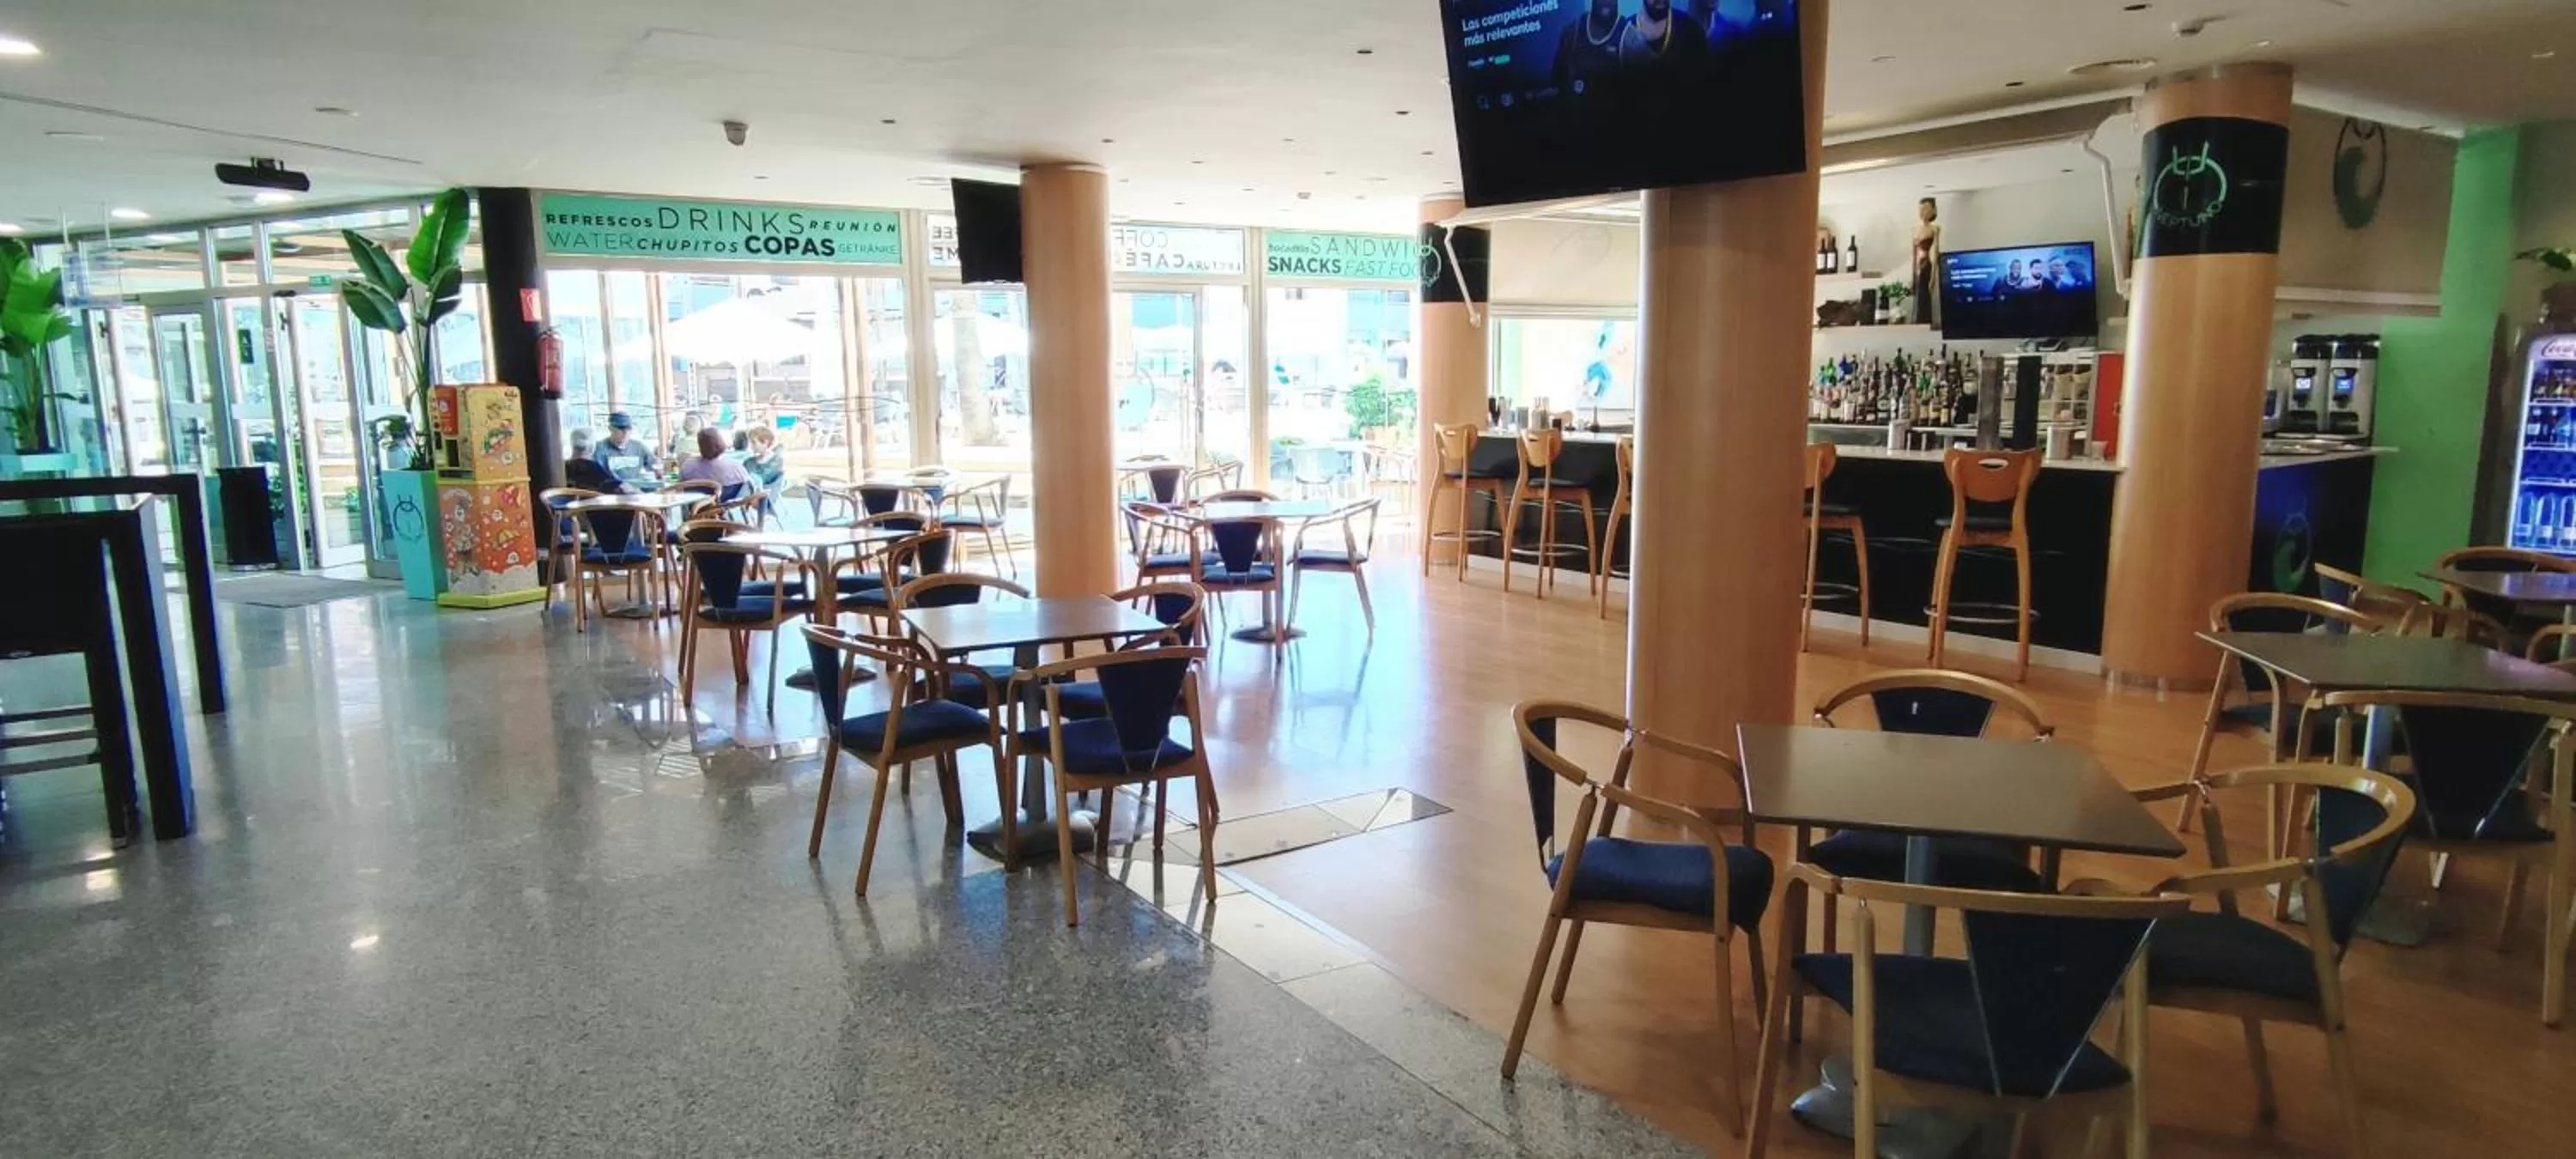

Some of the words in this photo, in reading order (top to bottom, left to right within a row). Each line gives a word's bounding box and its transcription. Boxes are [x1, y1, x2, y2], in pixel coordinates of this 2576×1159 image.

[1462, 19, 1479, 32] Las
[1486, 21, 1541, 42] relevantes
[546, 214, 653, 228] REFRESCOS
[659, 206, 805, 234] DRINKS
[547, 231, 634, 250] WATER
[636, 237, 738, 253] CHUPITOS
[744, 235, 835, 257] COPAS
[1268, 257, 1341, 274] SNACKS
[1345, 260, 1388, 276] FAST
